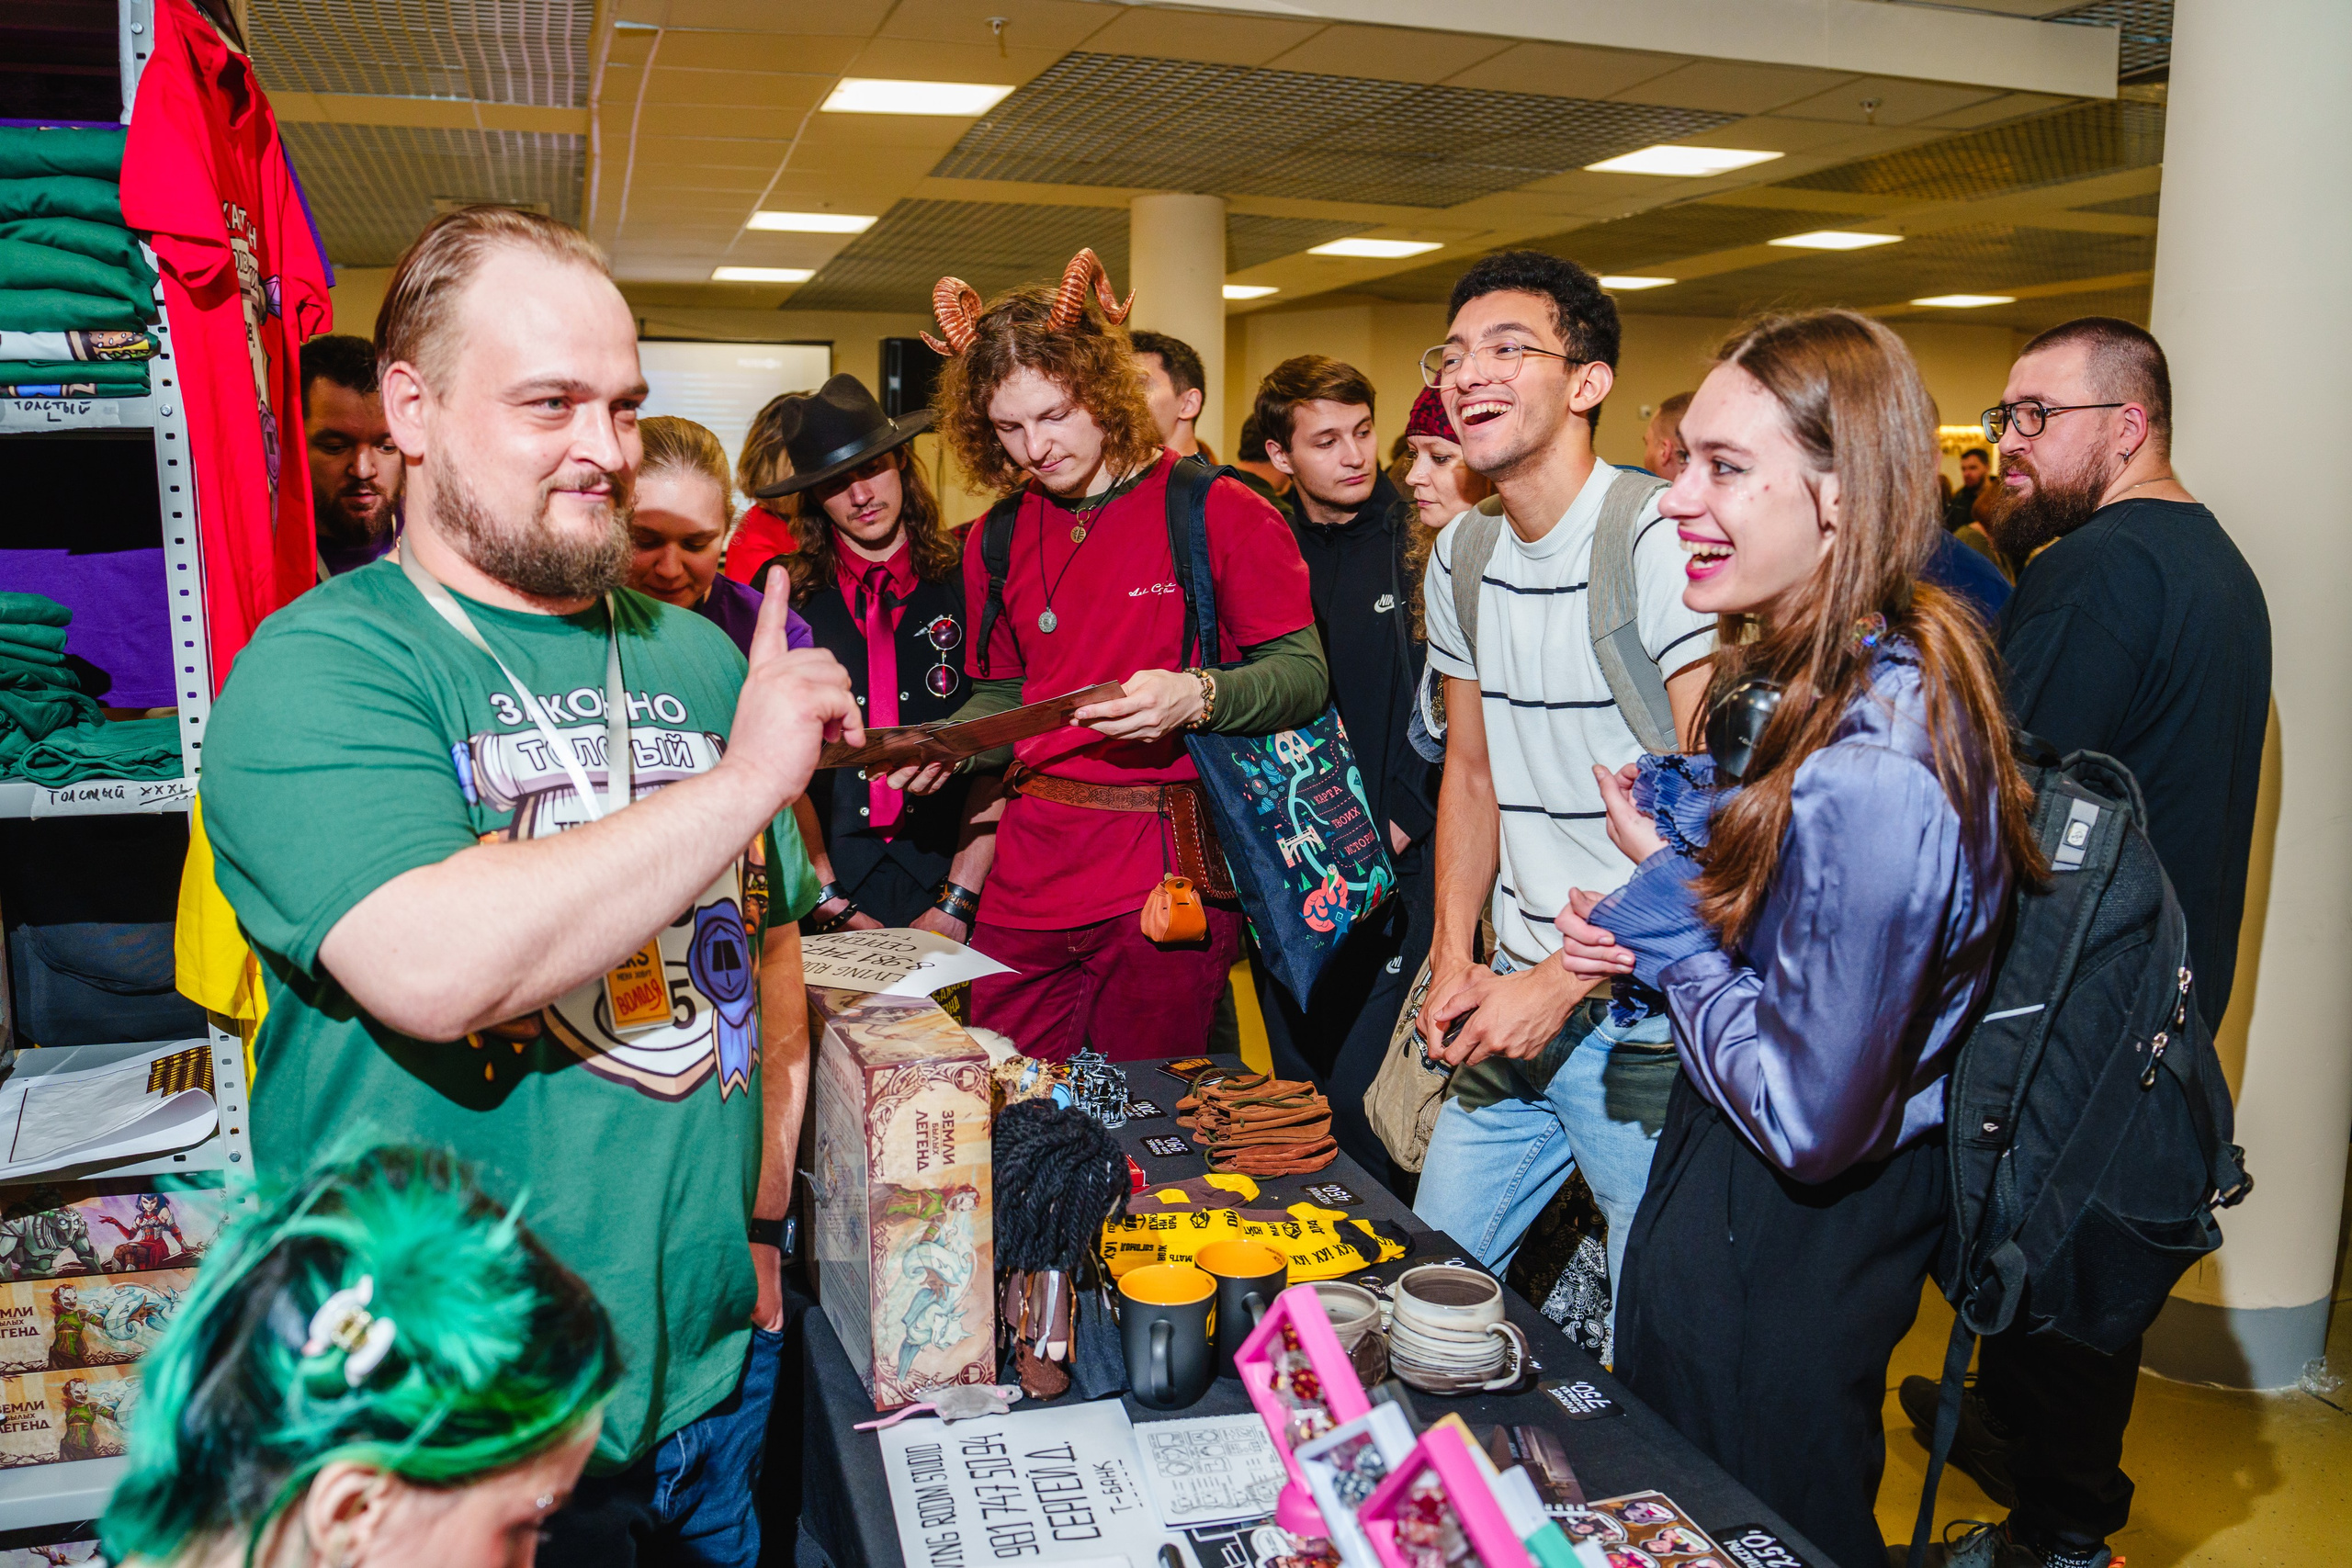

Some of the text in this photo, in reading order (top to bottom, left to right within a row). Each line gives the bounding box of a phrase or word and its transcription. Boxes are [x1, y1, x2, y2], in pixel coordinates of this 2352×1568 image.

[489, 687, 688, 726] ЗКОНО
[516, 733, 695, 772] ТЛЫЙ
[1313, 785, 1343, 805] КАРТА
[1330, 806, 1361, 829] ТВОИХ
[803, 961, 907, 983] LIVING RO
[857, 953, 913, 966] 981
[906, 962, 935, 971] 8
[616, 978, 663, 1017] ВОЛОДЯ
[915, 1108, 930, 1174] ЛЕГЕНД
[932, 1122, 940, 1156] БЫЛЫХ
[942, 1110, 956, 1166] ЗЕМЛИ
[905, 1442, 965, 1568] ING ROOM STUDIO
[975, 1484, 1027, 1520] 747
[1024, 1464, 1102, 1541] СЕРГЕЙ
[986, 1521, 1039, 1559] 981
